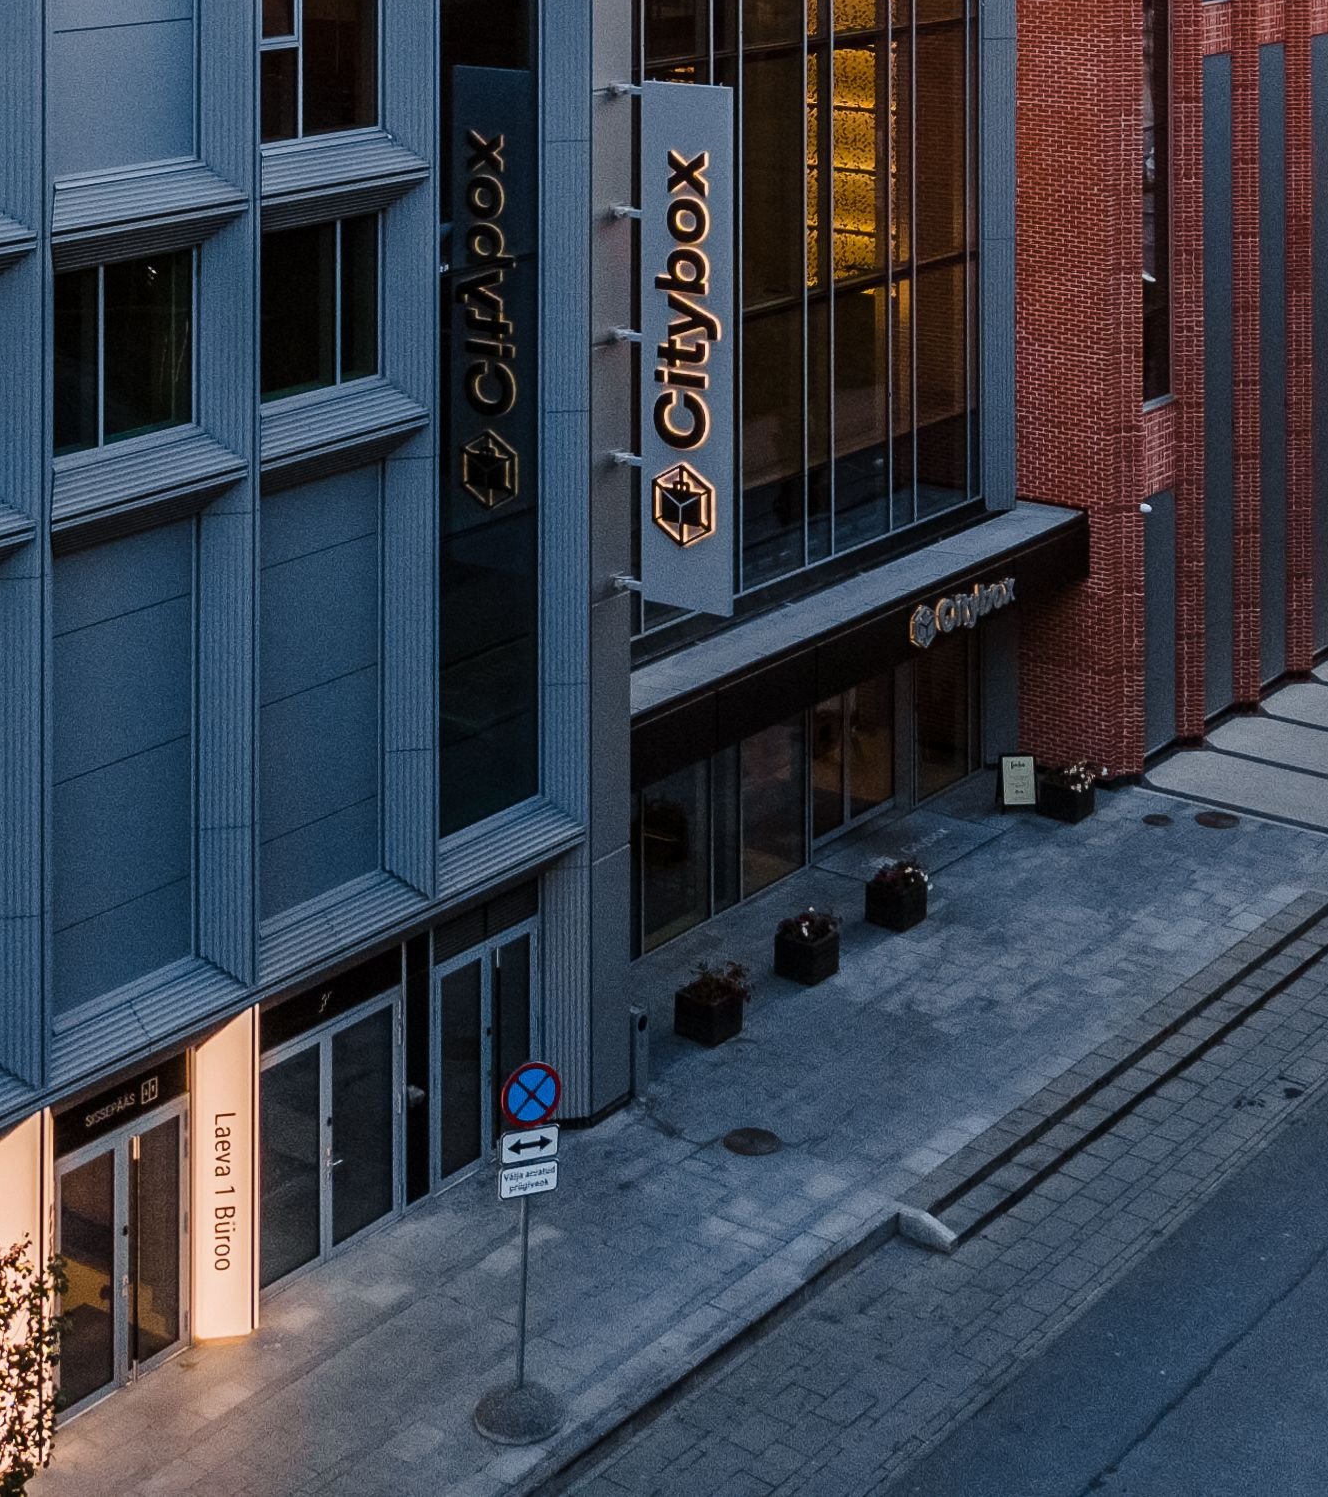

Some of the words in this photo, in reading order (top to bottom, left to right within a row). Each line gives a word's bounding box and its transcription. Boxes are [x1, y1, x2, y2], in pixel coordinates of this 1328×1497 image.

[653, 149, 721, 450] Citybox
[214, 1112, 237, 1177] Laeva
[214, 1185, 236, 1195] 1
[214, 1205, 237, 1272] Büroo
